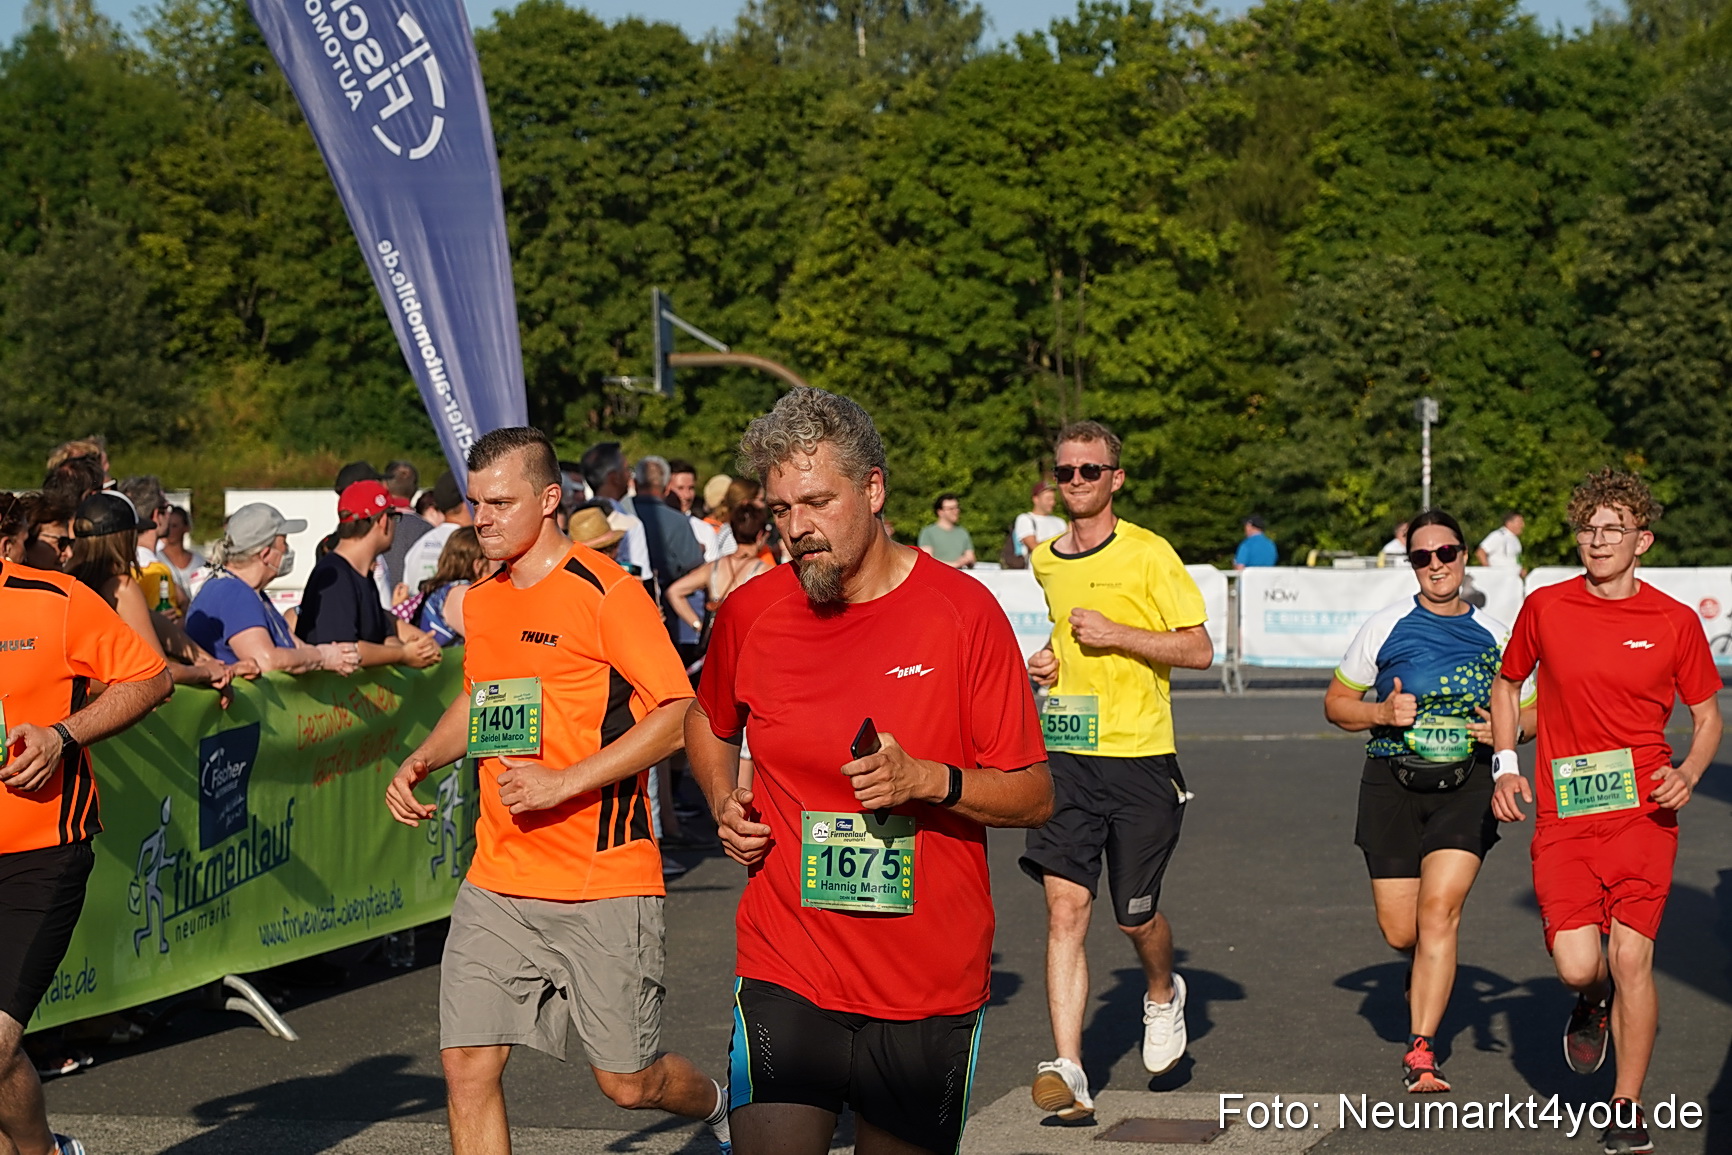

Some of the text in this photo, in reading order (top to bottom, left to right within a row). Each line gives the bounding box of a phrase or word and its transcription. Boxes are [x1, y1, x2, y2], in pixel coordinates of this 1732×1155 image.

[520, 630, 559, 647] THULE
[897, 664, 922, 679] DEHN
[471, 717, 479, 743] RUN
[480, 704, 525, 731] 1401
[529, 708, 538, 743] 2022
[1047, 715, 1081, 732] 550
[1088, 717, 1096, 743] 2022
[480, 733, 524, 743] Seidel Marco
[1422, 728, 1460, 744] 705
[1559, 785, 1569, 806] RUN
[1568, 771, 1622, 796] 1702
[1623, 772, 1634, 800] 2022
[1597, 793, 1620, 801] Moritz
[830, 831, 867, 839] Firmenlauf
[174, 797, 295, 914] firmenlauf
[820, 846, 901, 880] 1675
[807, 855, 817, 889] RUN
[901, 855, 911, 899] 2022
[820, 880, 897, 894] Hannig Martin
[175, 899, 231, 943] neumarkt
